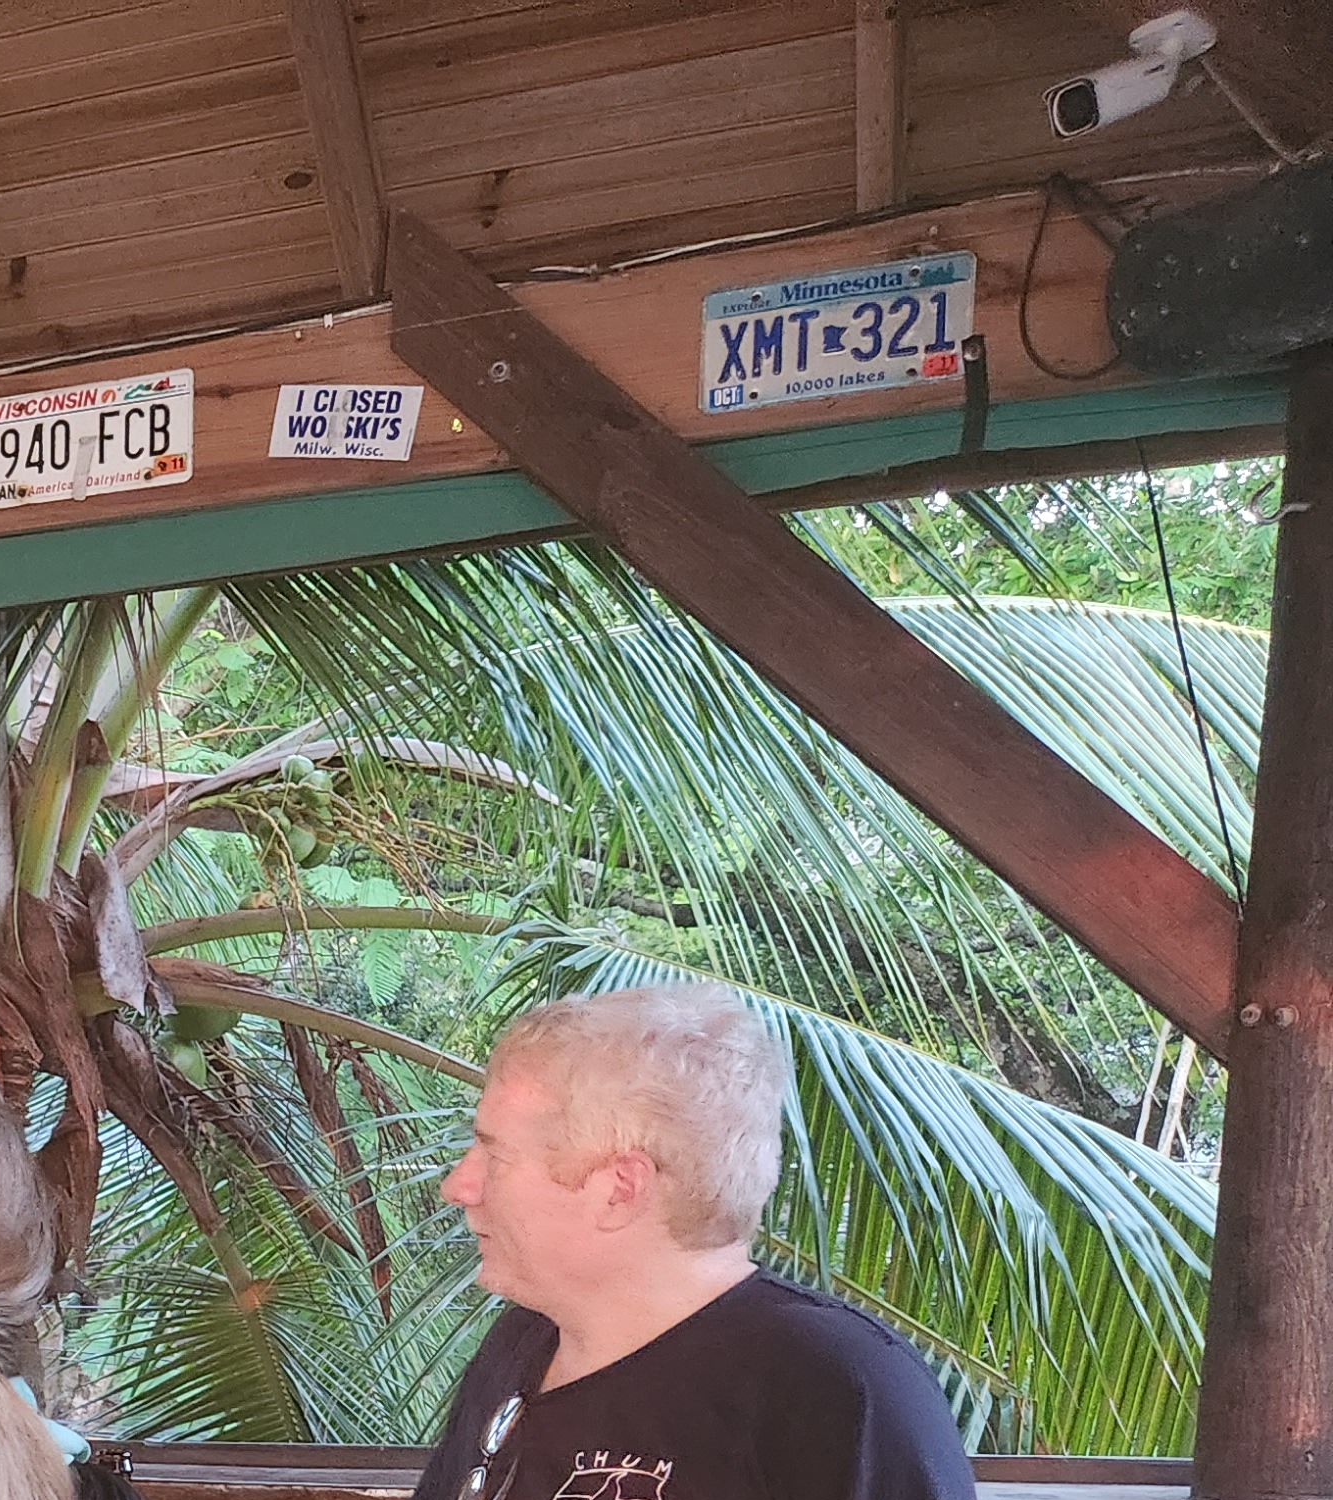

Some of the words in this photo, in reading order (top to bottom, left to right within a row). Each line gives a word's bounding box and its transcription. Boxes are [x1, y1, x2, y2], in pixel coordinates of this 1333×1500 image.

[780, 272, 902, 303] Minnesota
[718, 310, 819, 384] XMT
[851, 292, 955, 362] 321
[785, 376, 834, 395] 10,000
[839, 370, 886, 387] lakes
[296, 390, 305, 412] I
[288, 416, 402, 441] WOSKI'S
[0, 419, 70, 479] 940
[99, 404, 171, 464] FCB
[294, 442, 336, 456] Milw.
[345, 443, 384, 457] Wisc.
